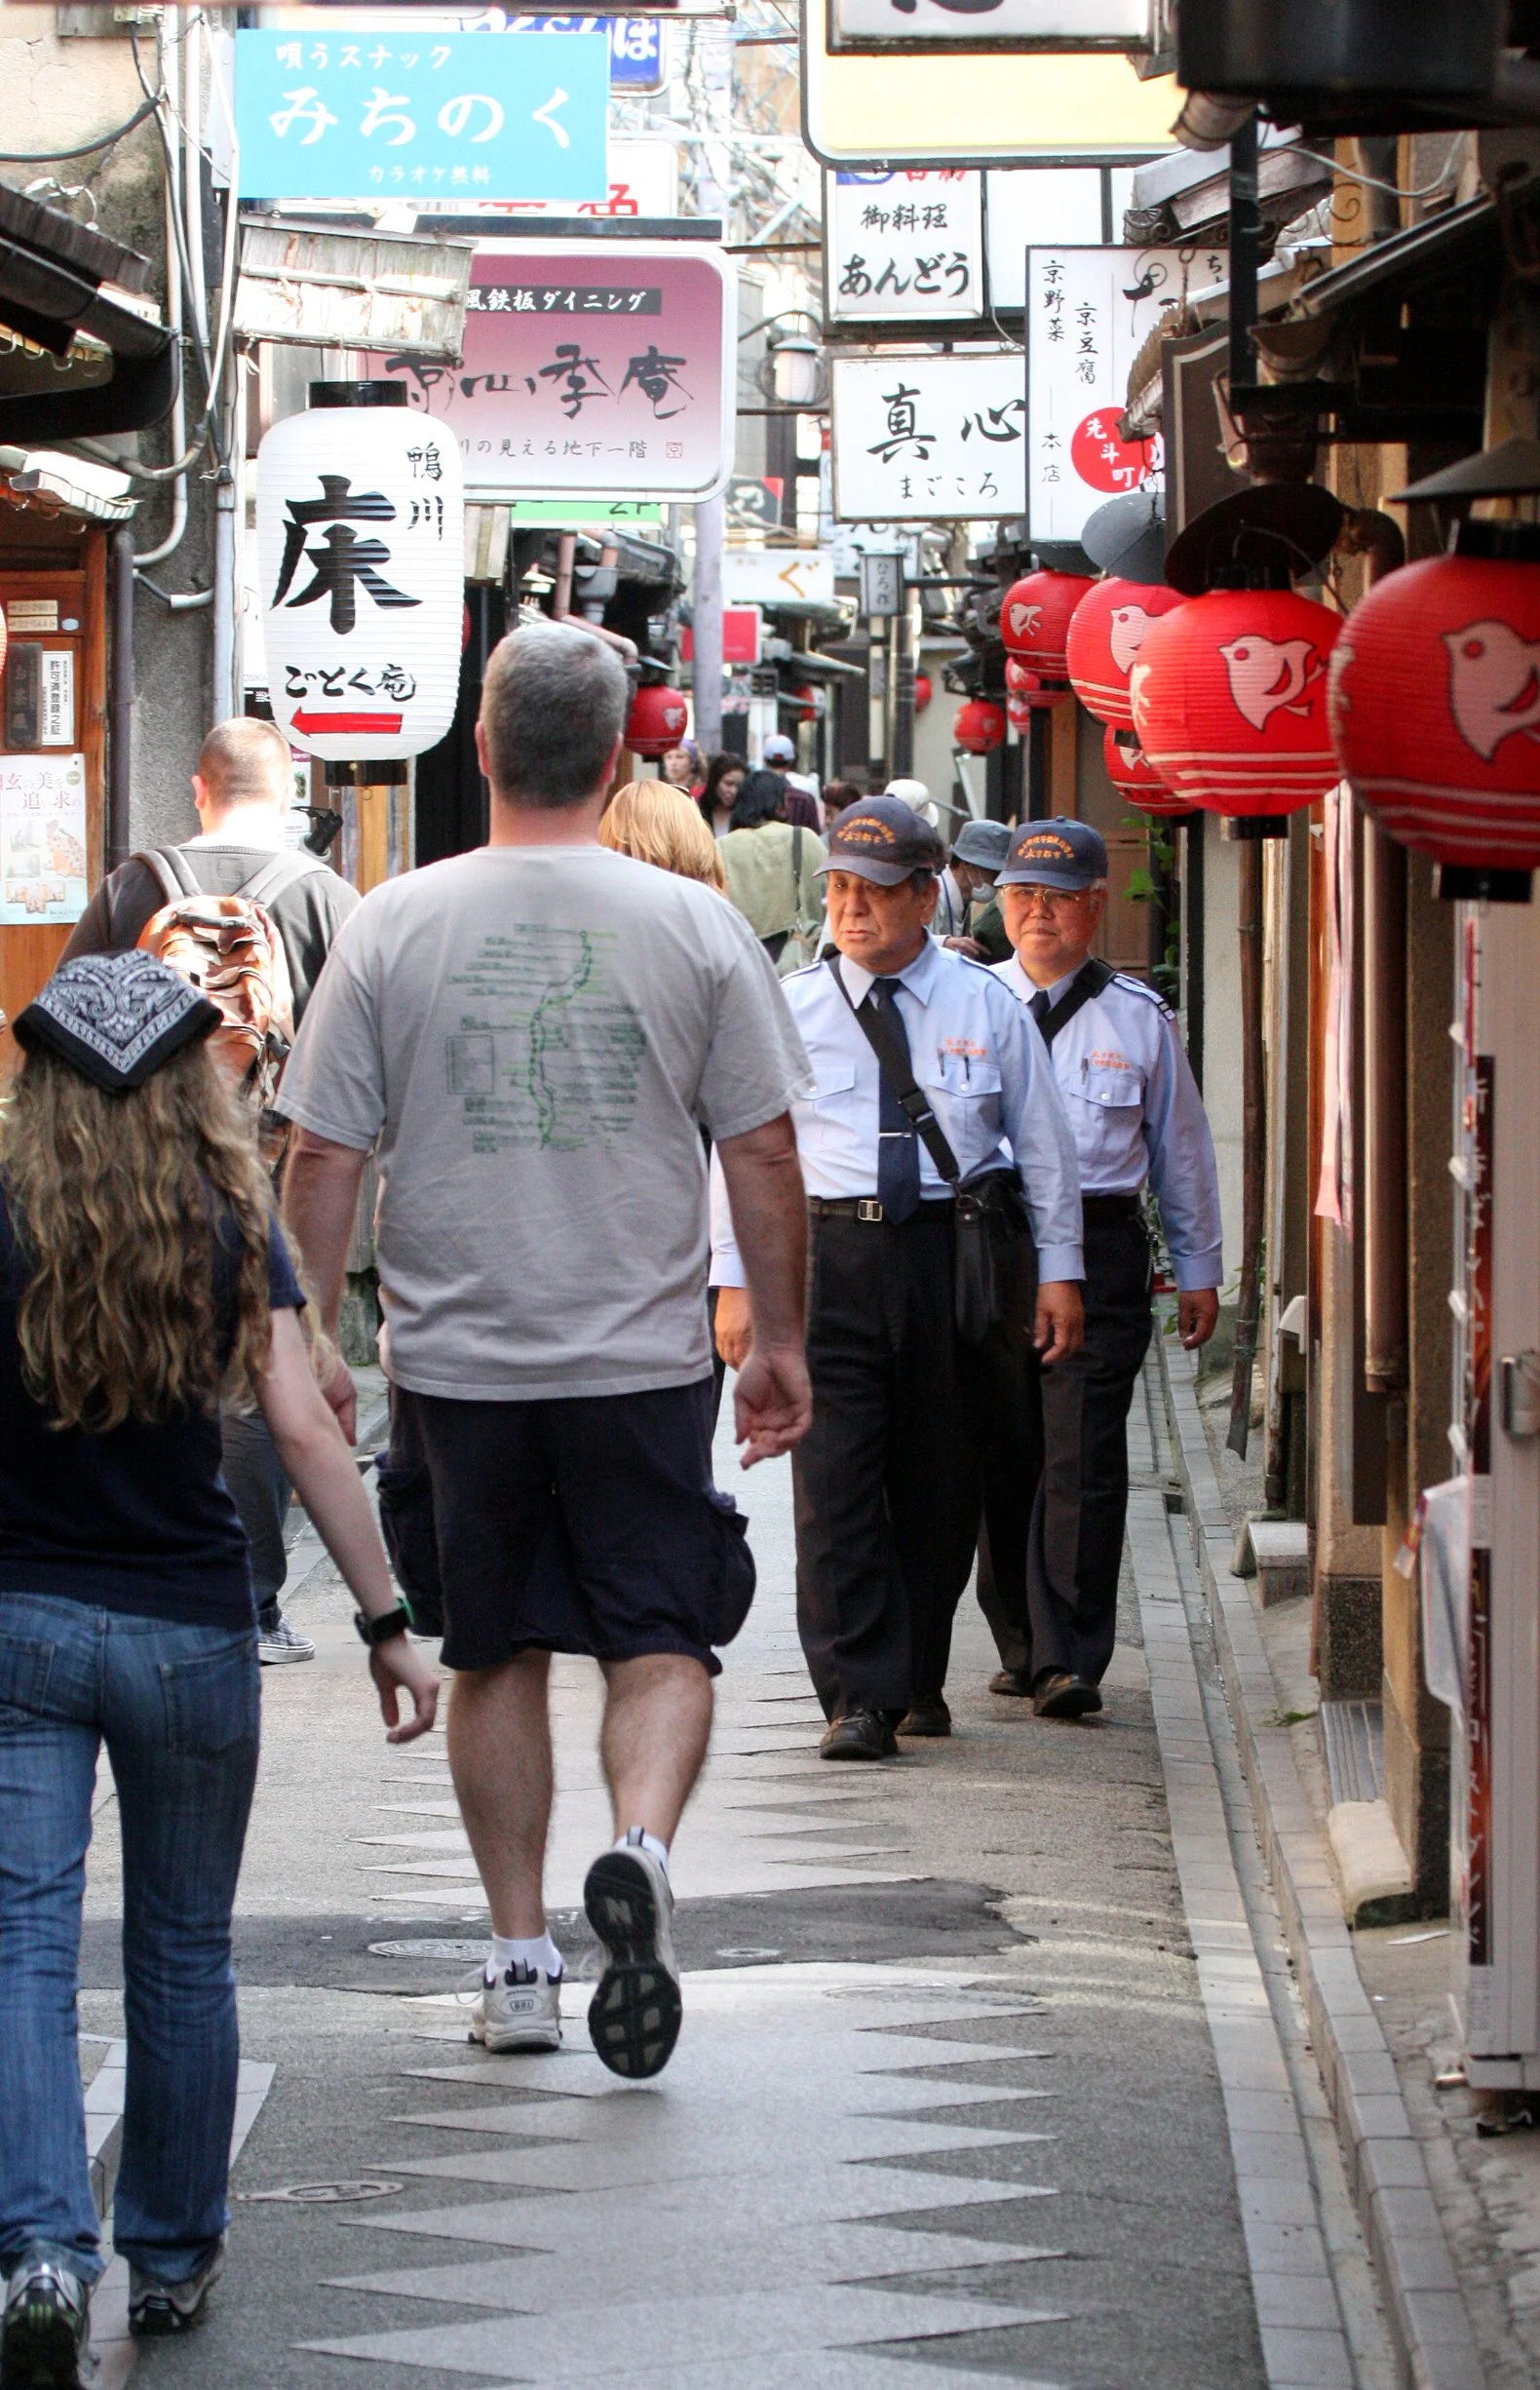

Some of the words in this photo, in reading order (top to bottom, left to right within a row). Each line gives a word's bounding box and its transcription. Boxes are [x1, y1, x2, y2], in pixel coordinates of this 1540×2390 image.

[276, 41, 452, 70] 唄うスナック
[268, 86, 570, 149] みちのく
[368, 165, 491, 185] カラオケ無料
[861, 203, 948, 234] 御料理
[838, 251, 970, 298] あんどう
[1042, 259, 1065, 342] 京野菜
[1074, 301, 1099, 385] 京豆腐
[866, 382, 1026, 464] 真心
[1041, 432, 1062, 483] 本店
[1085, 416, 1136, 488] 先斗町
[405, 441, 444, 541] 鴨川
[898, 472, 999, 499] まごころ
[269, 475, 424, 636] 床
[285, 663, 418, 702] ごとく庵
